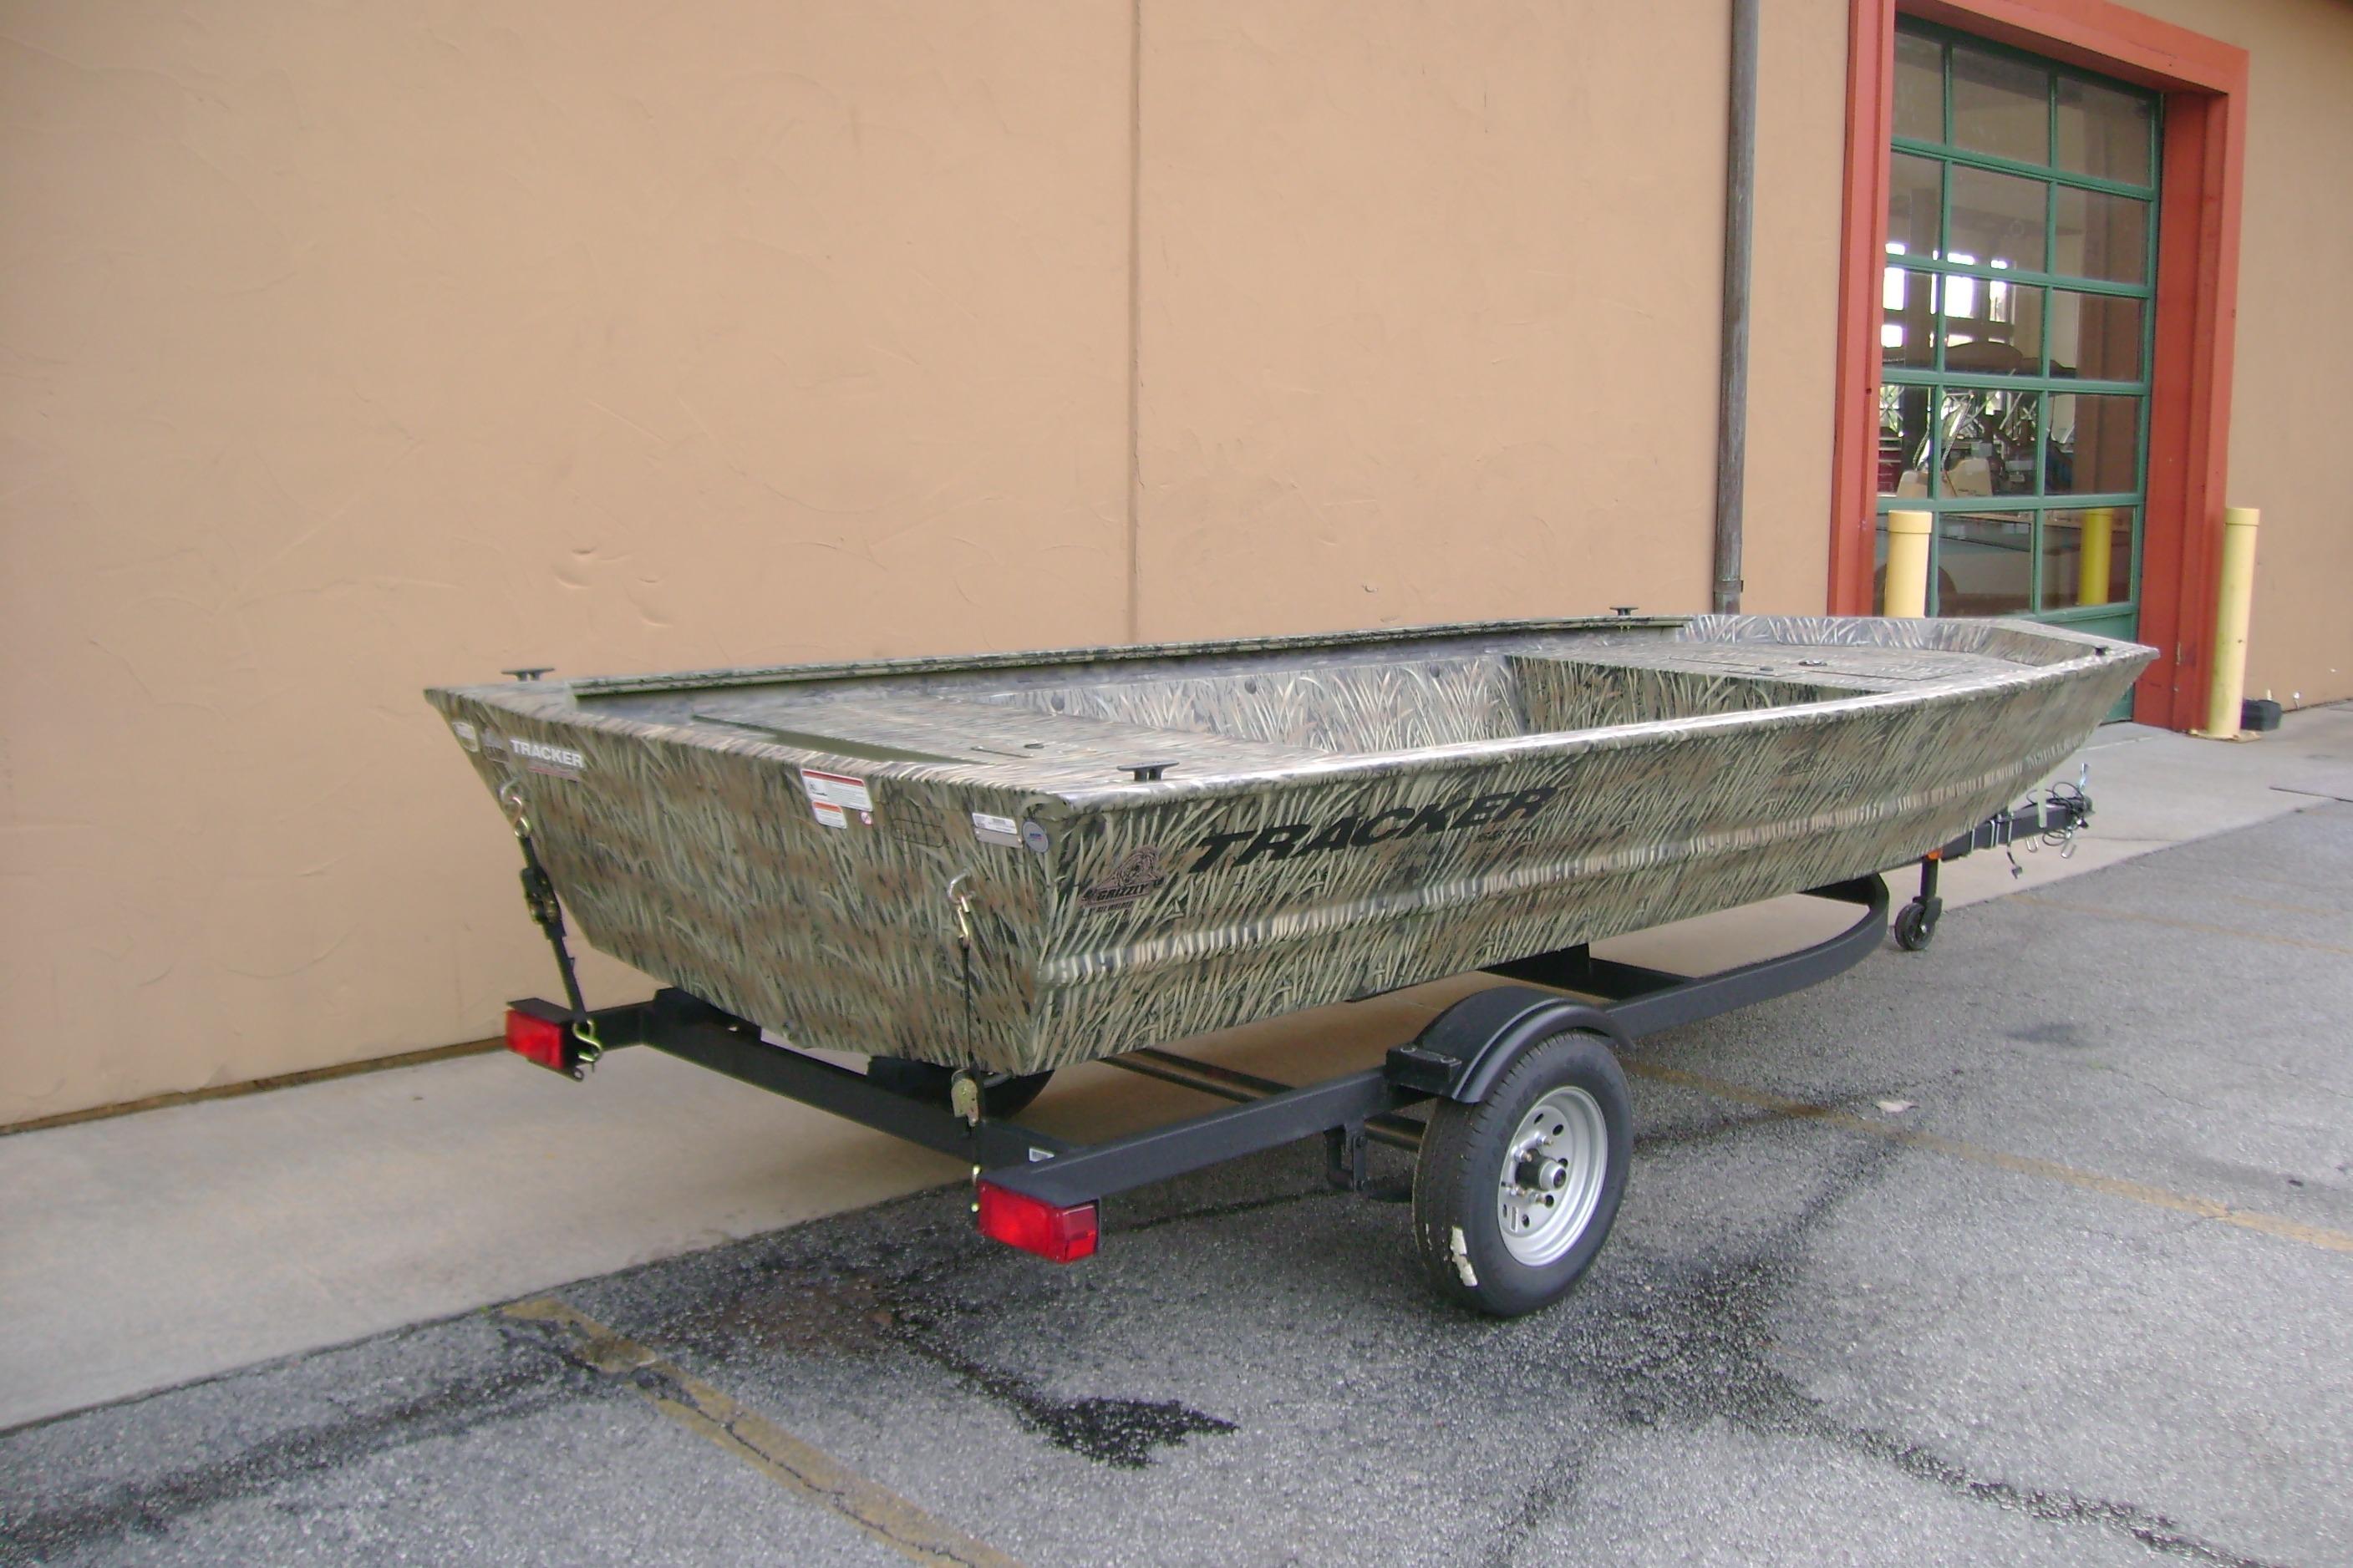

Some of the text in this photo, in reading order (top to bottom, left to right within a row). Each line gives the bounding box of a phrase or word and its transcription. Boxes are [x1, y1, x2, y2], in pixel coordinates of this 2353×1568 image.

[509, 738, 585, 768] TRACKER
[1189, 787, 1558, 873] TRACKER
[1096, 884, 1149, 901] GRIZZLY
